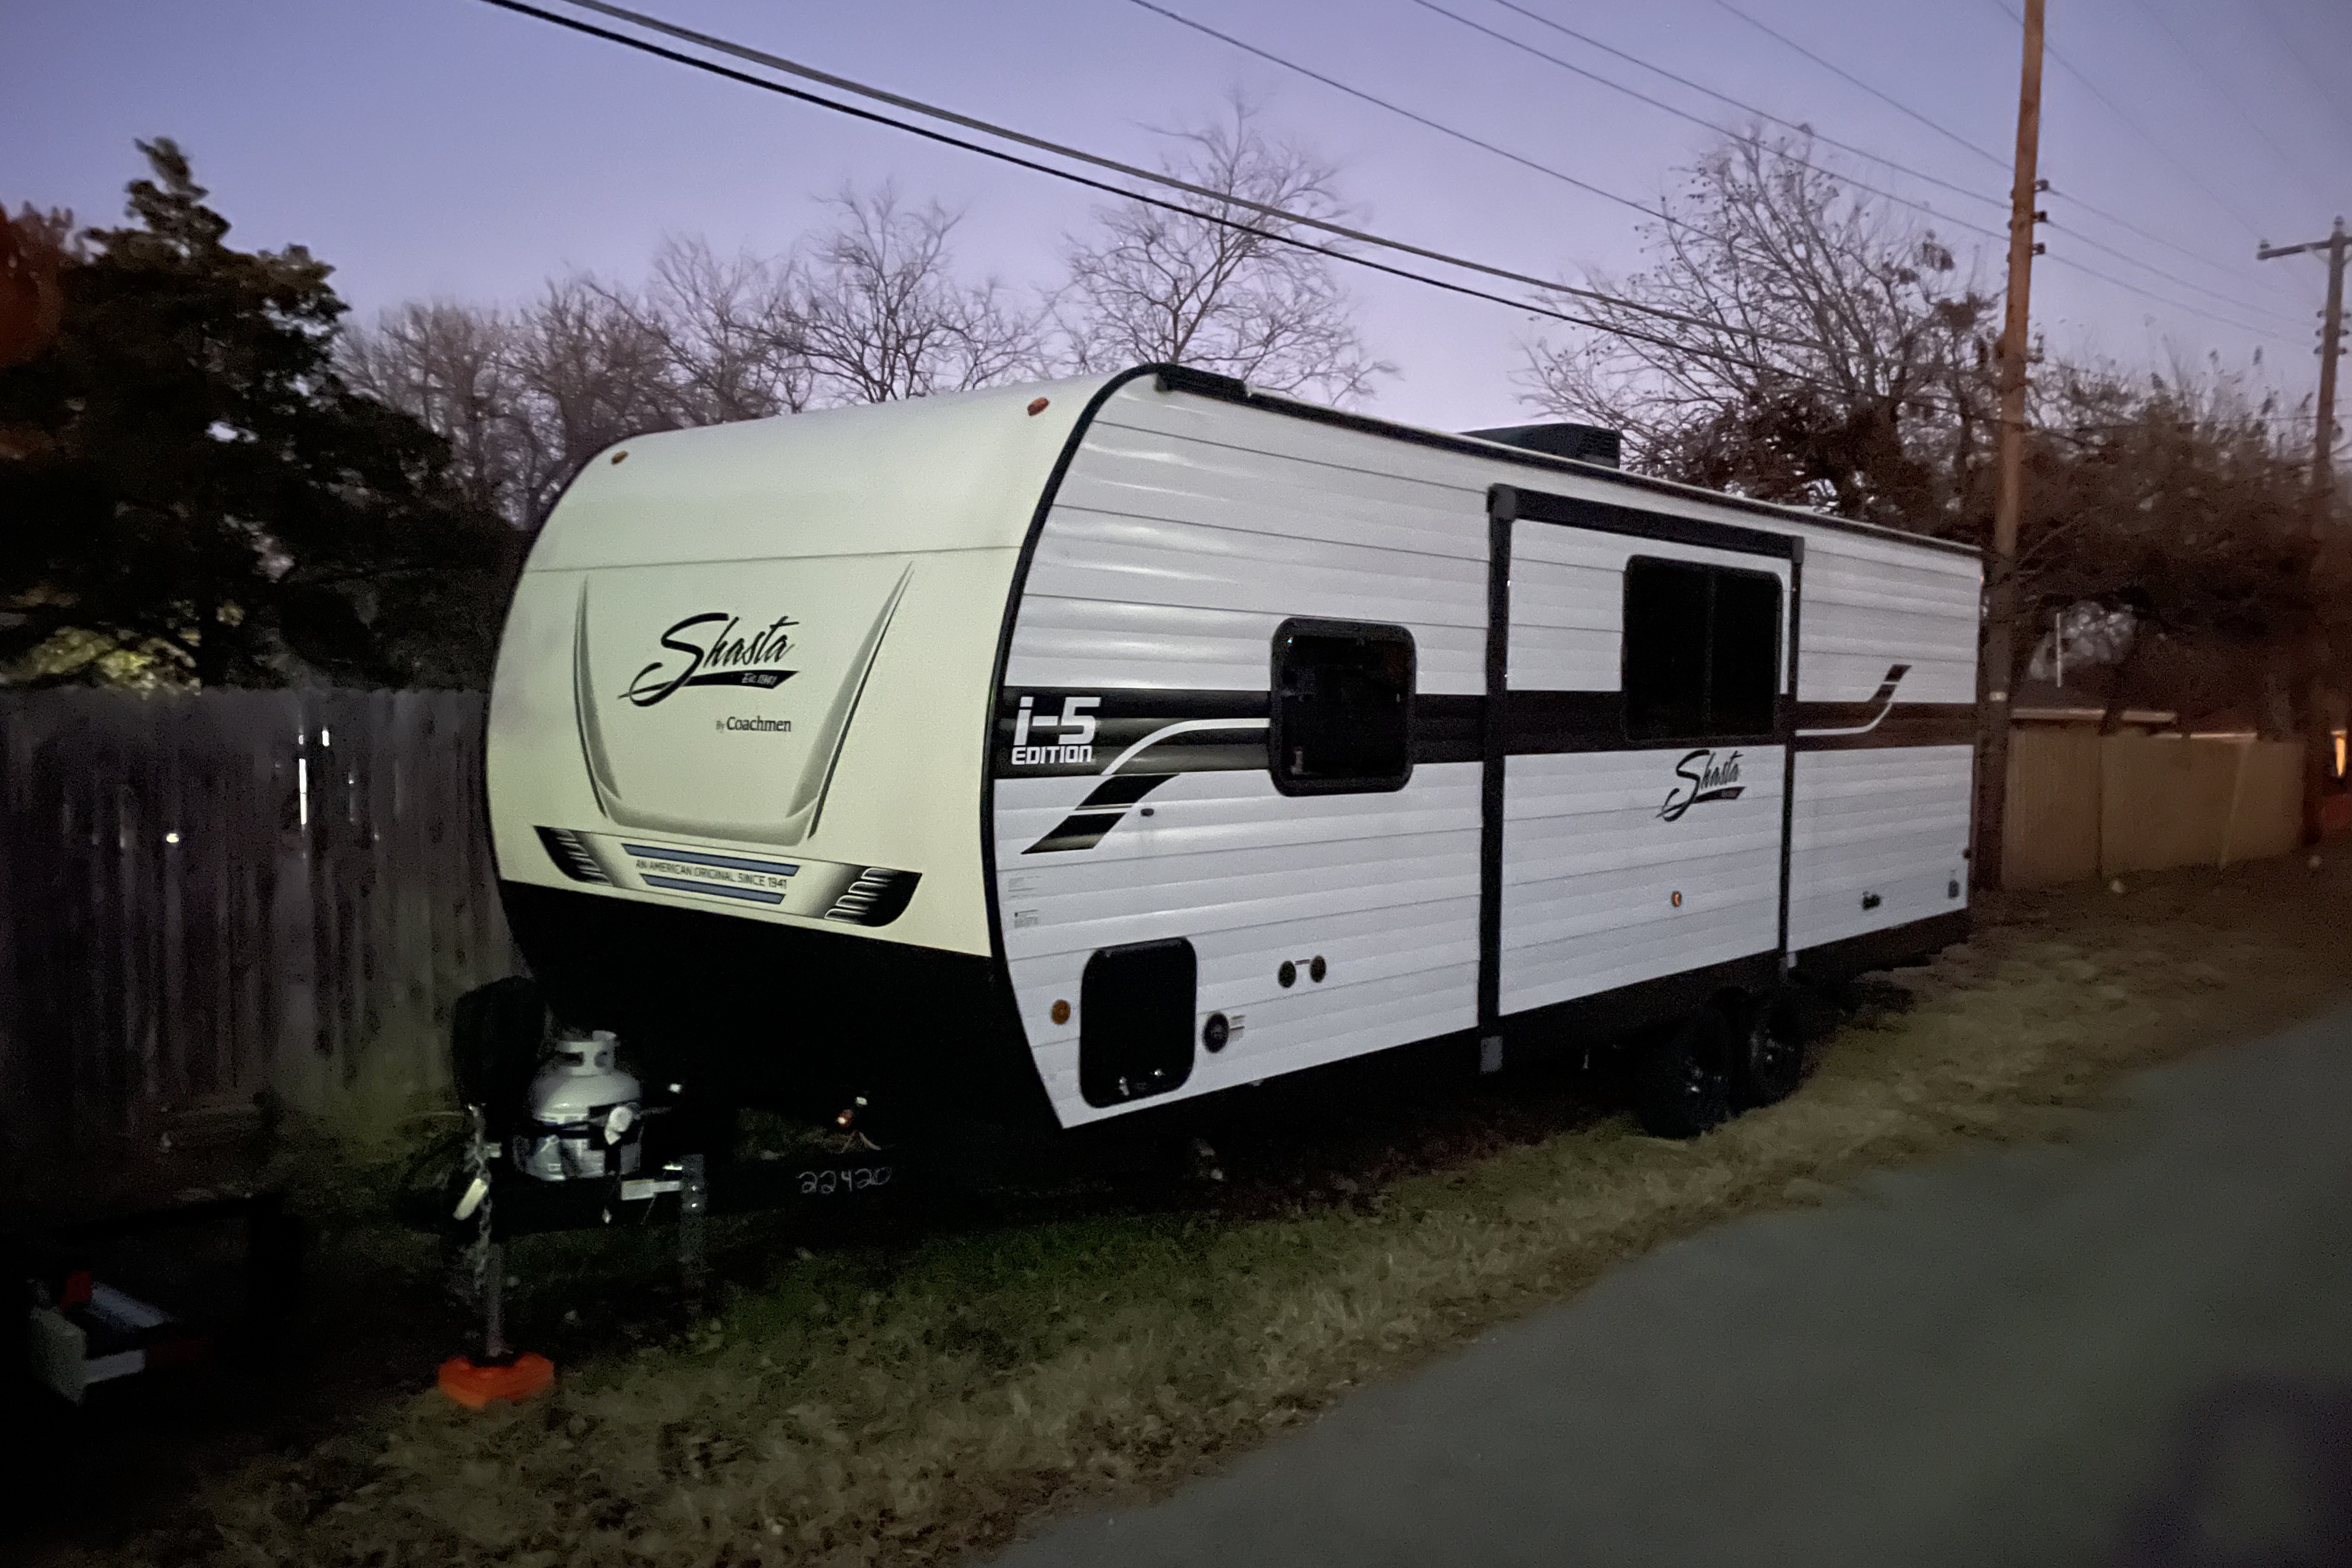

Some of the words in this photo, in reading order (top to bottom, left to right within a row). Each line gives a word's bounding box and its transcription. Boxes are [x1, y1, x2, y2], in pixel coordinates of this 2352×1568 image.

[629, 612, 800, 707] Shasta
[726, 716, 792, 732] Coachmen
[1012, 745, 1093, 765] EDITION
[1662, 749, 1744, 822] Shasta
[649, 860, 692, 876] AMERICAN
[695, 867, 736, 883] ORIGINAL
[737, 873, 766, 887] SINCE
[796, 1167, 892, 1194] 22420
